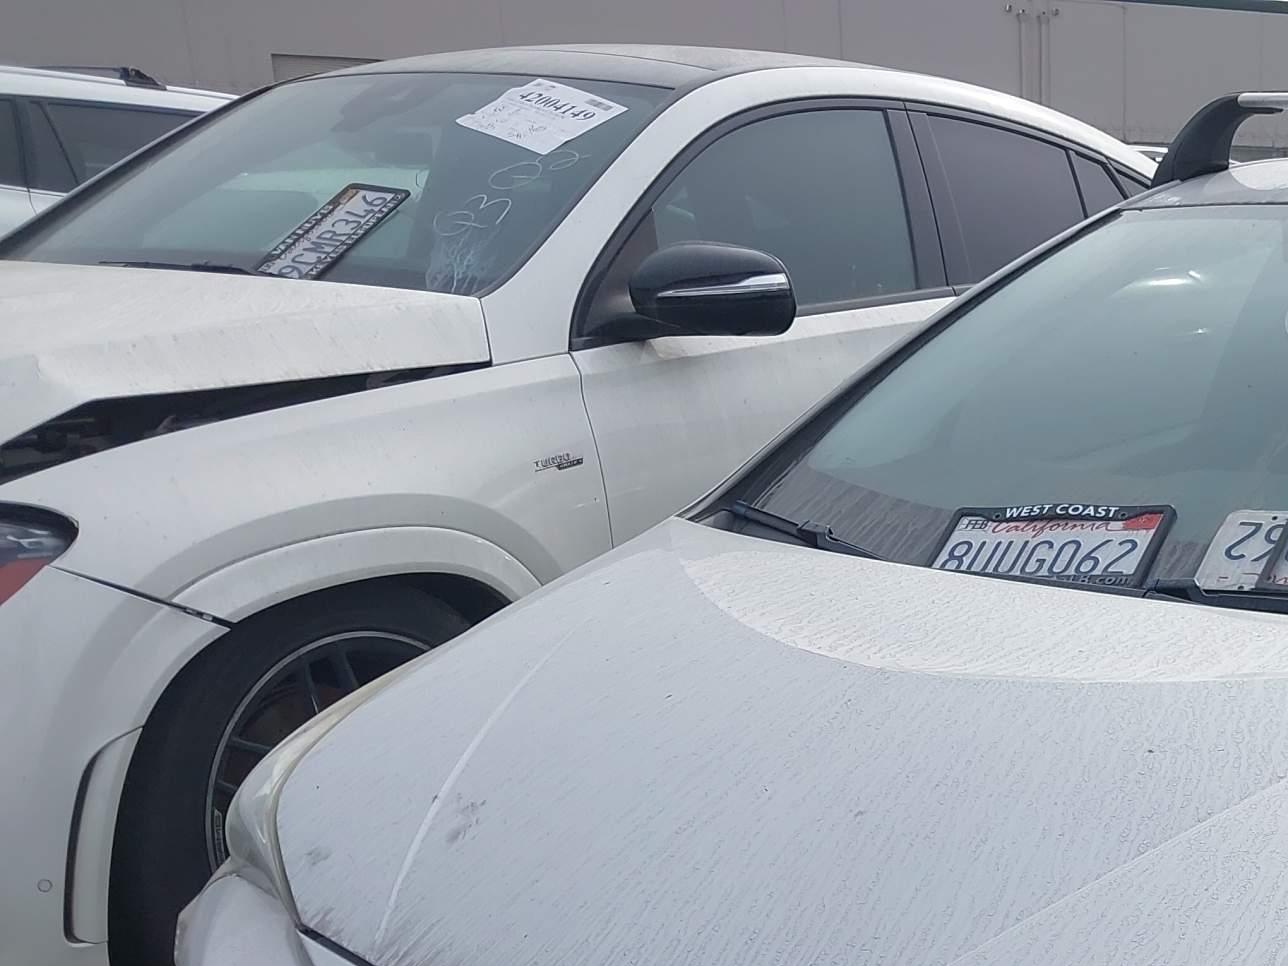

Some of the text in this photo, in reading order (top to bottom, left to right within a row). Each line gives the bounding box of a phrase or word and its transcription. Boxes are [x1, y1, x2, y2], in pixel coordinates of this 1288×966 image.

[519, 90, 597, 121] 42004149
[278, 194, 388, 279] 9CMR346
[964, 519, 990, 530] FEB
[1005, 504, 1119, 519] WEST COAST
[991, 518, 1111, 540] California
[939, 538, 1139, 577] 8UUG062
